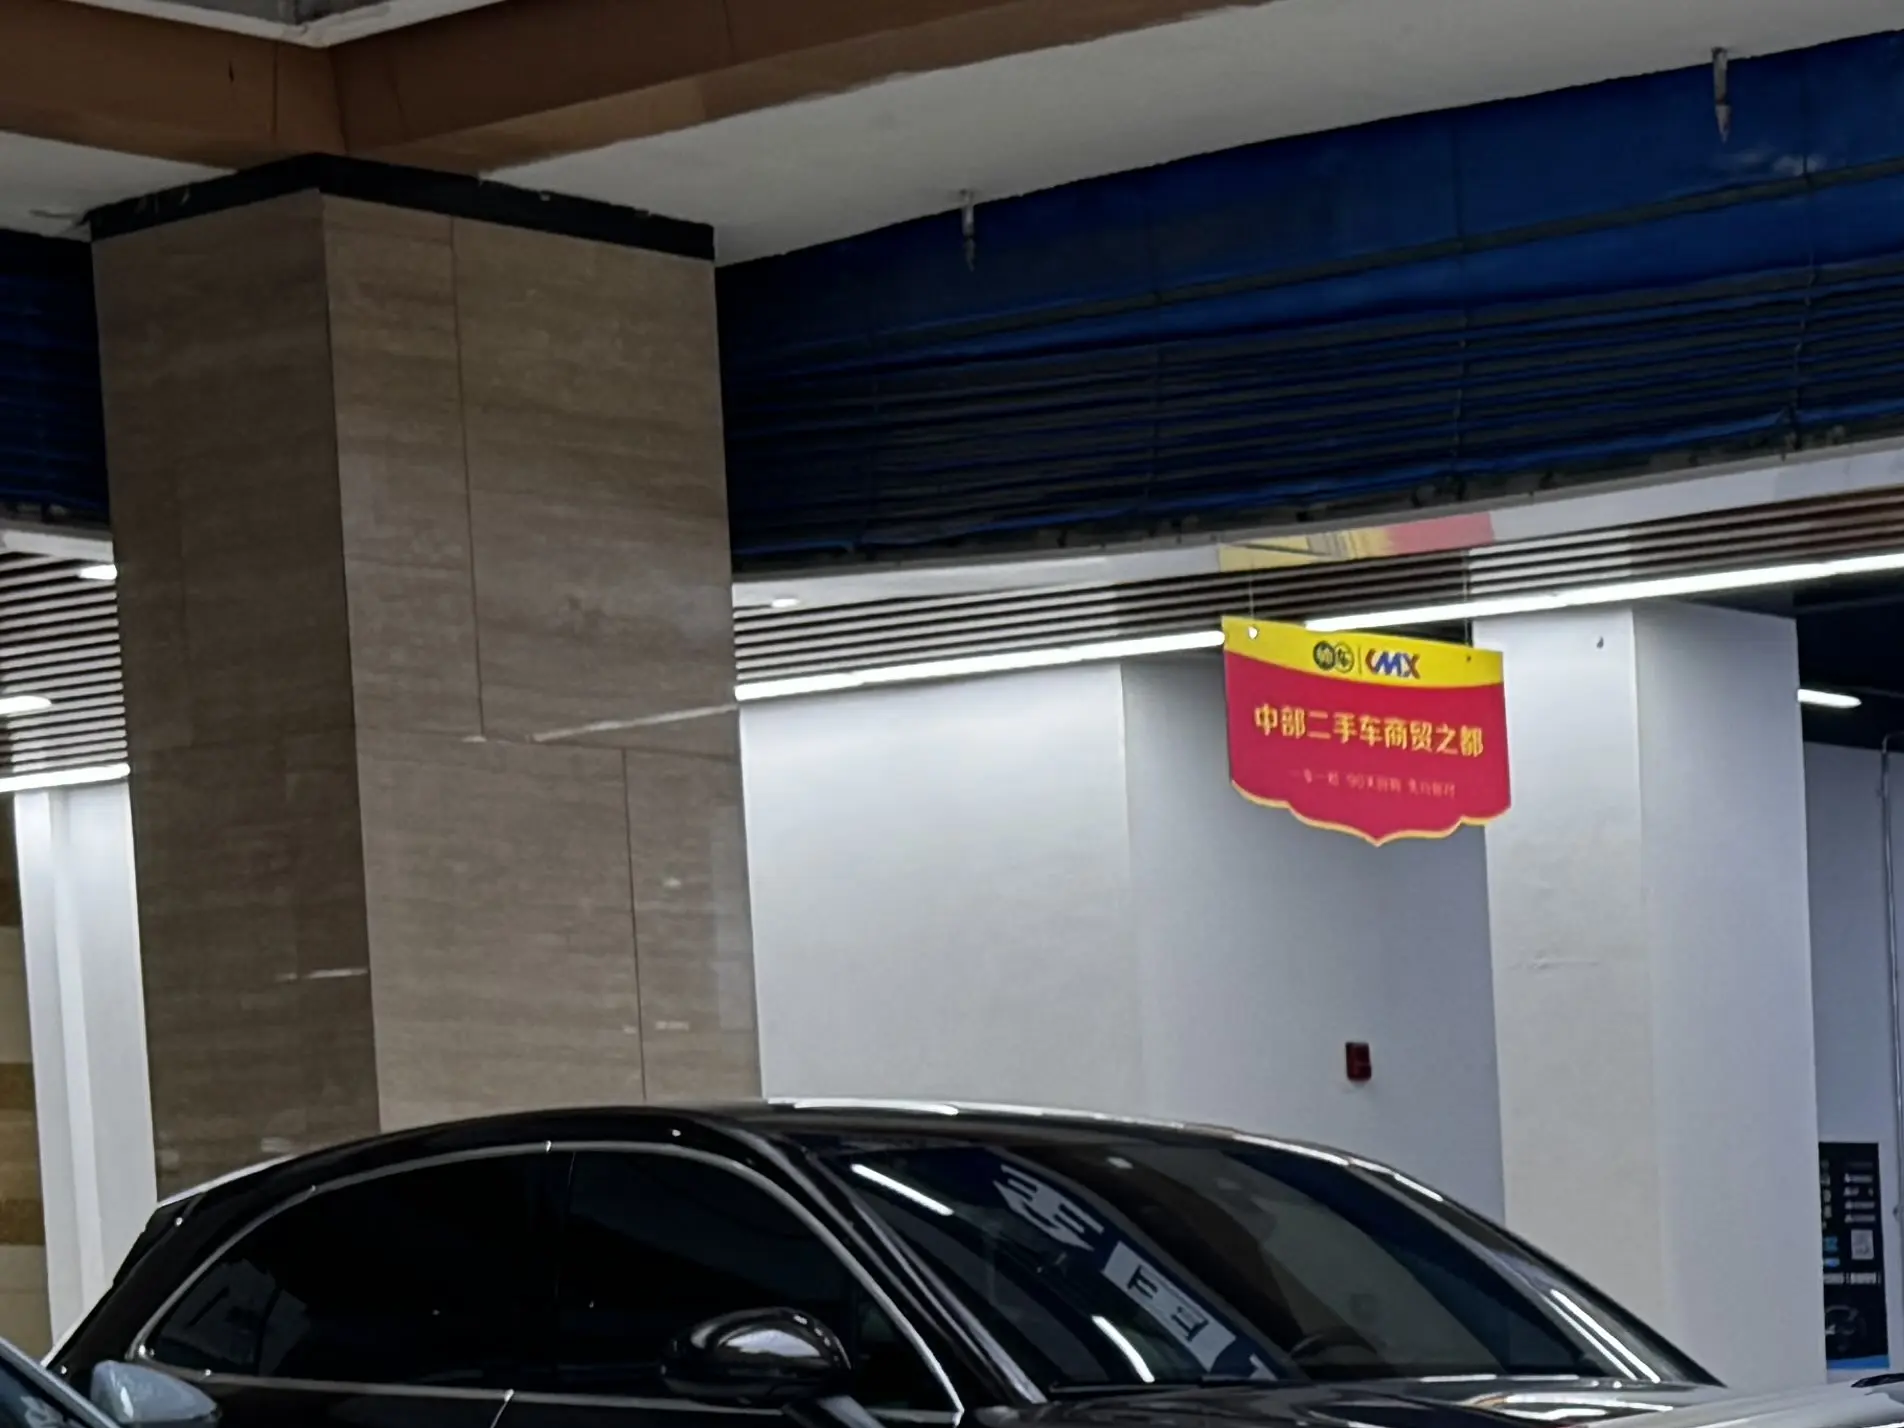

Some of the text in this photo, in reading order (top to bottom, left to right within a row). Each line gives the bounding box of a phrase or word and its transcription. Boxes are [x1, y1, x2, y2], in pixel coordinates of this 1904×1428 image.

[1254, 702, 1485, 758] 中部二手车商贸之都
